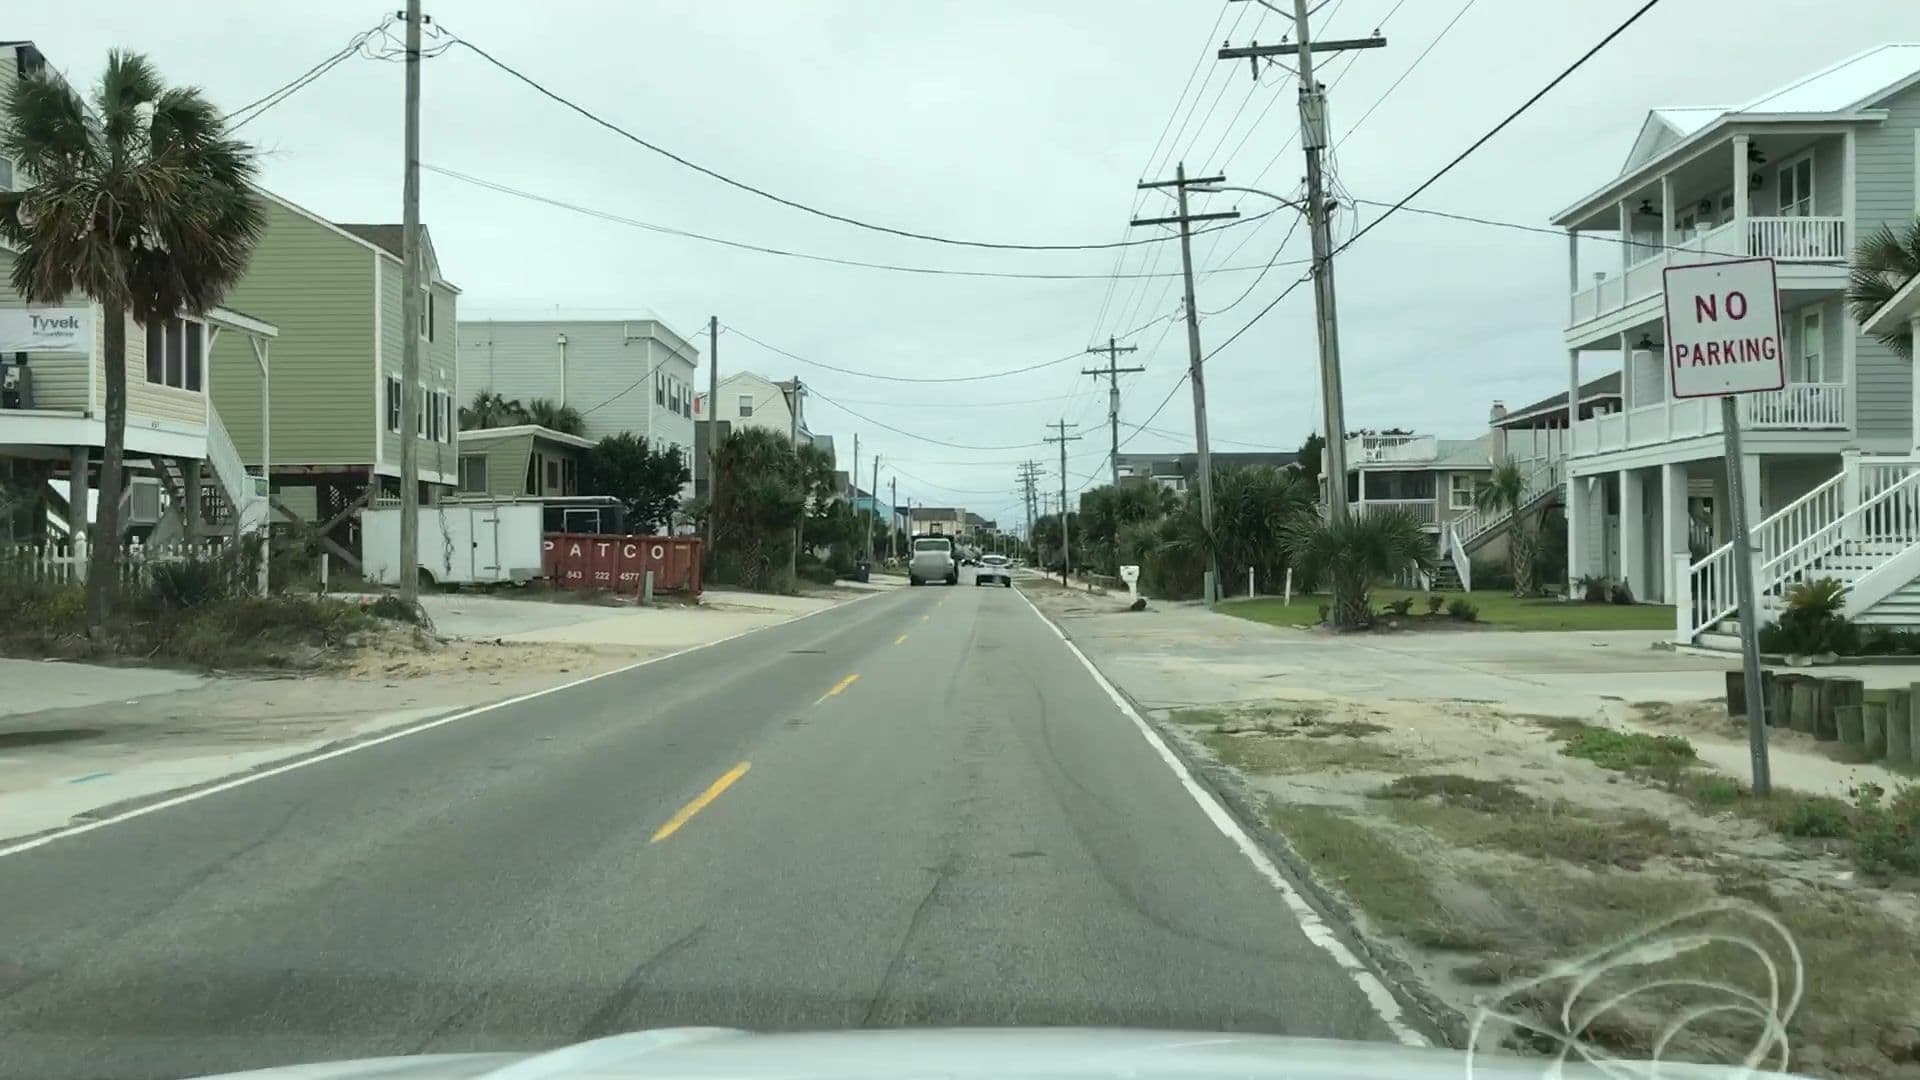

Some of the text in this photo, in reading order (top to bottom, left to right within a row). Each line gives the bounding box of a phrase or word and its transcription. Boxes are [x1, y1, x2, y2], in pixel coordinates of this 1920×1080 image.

[1695, 291, 1747, 323] NO
[29, 315, 79, 330] Tyvek
[1675, 336, 1775, 368] PARKING
[594, 571, 610, 581] 222
[619, 572, 640, 581] 4577
